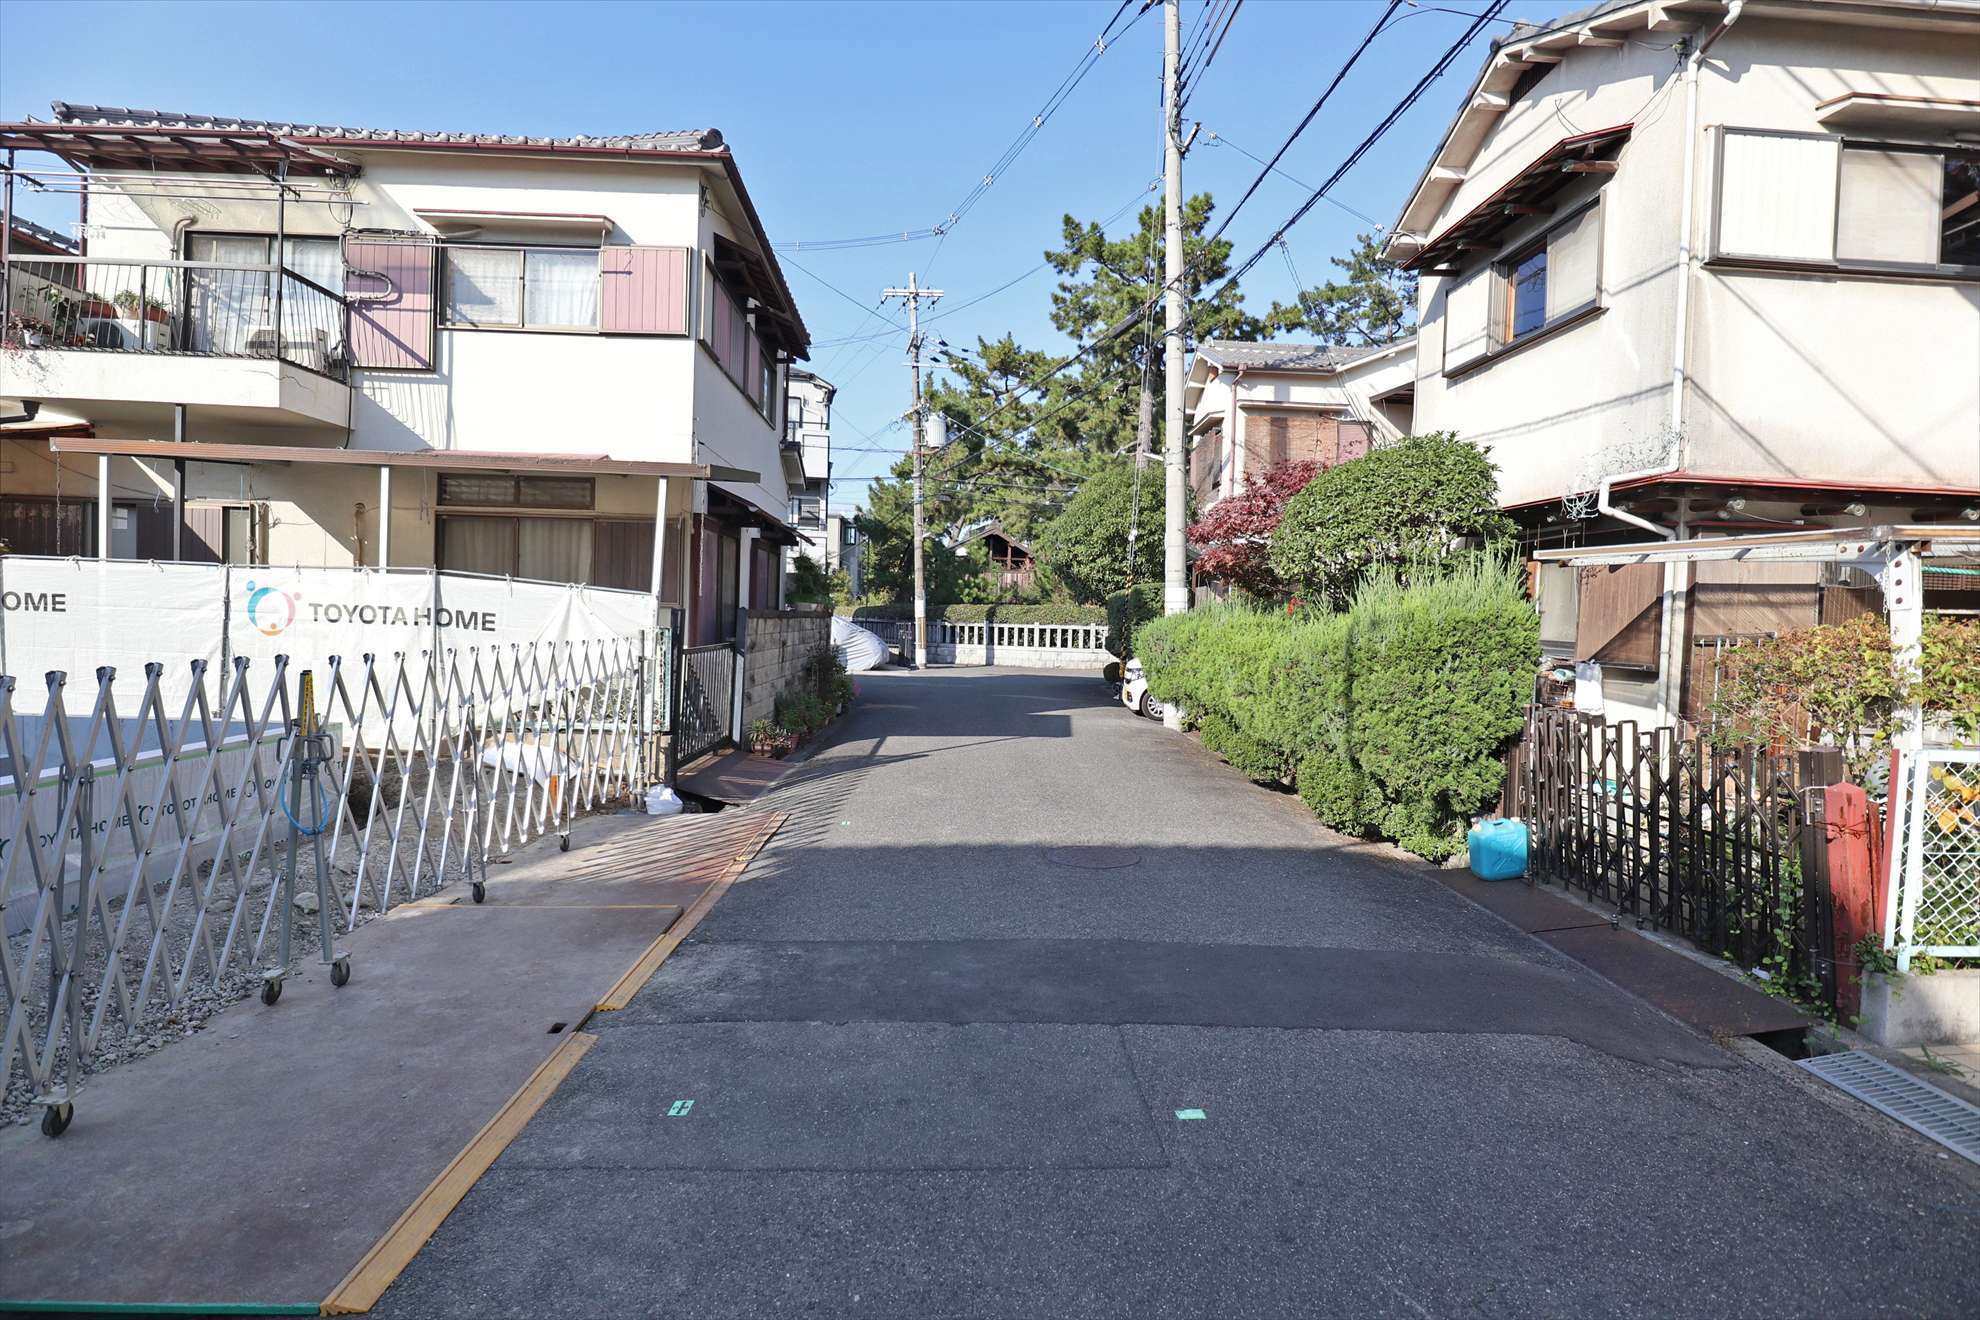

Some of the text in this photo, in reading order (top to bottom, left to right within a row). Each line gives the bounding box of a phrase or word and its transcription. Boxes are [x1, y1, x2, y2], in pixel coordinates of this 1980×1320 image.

[1, 591, 66, 612] OME
[308, 603, 496, 632] TOYOTA HOME
